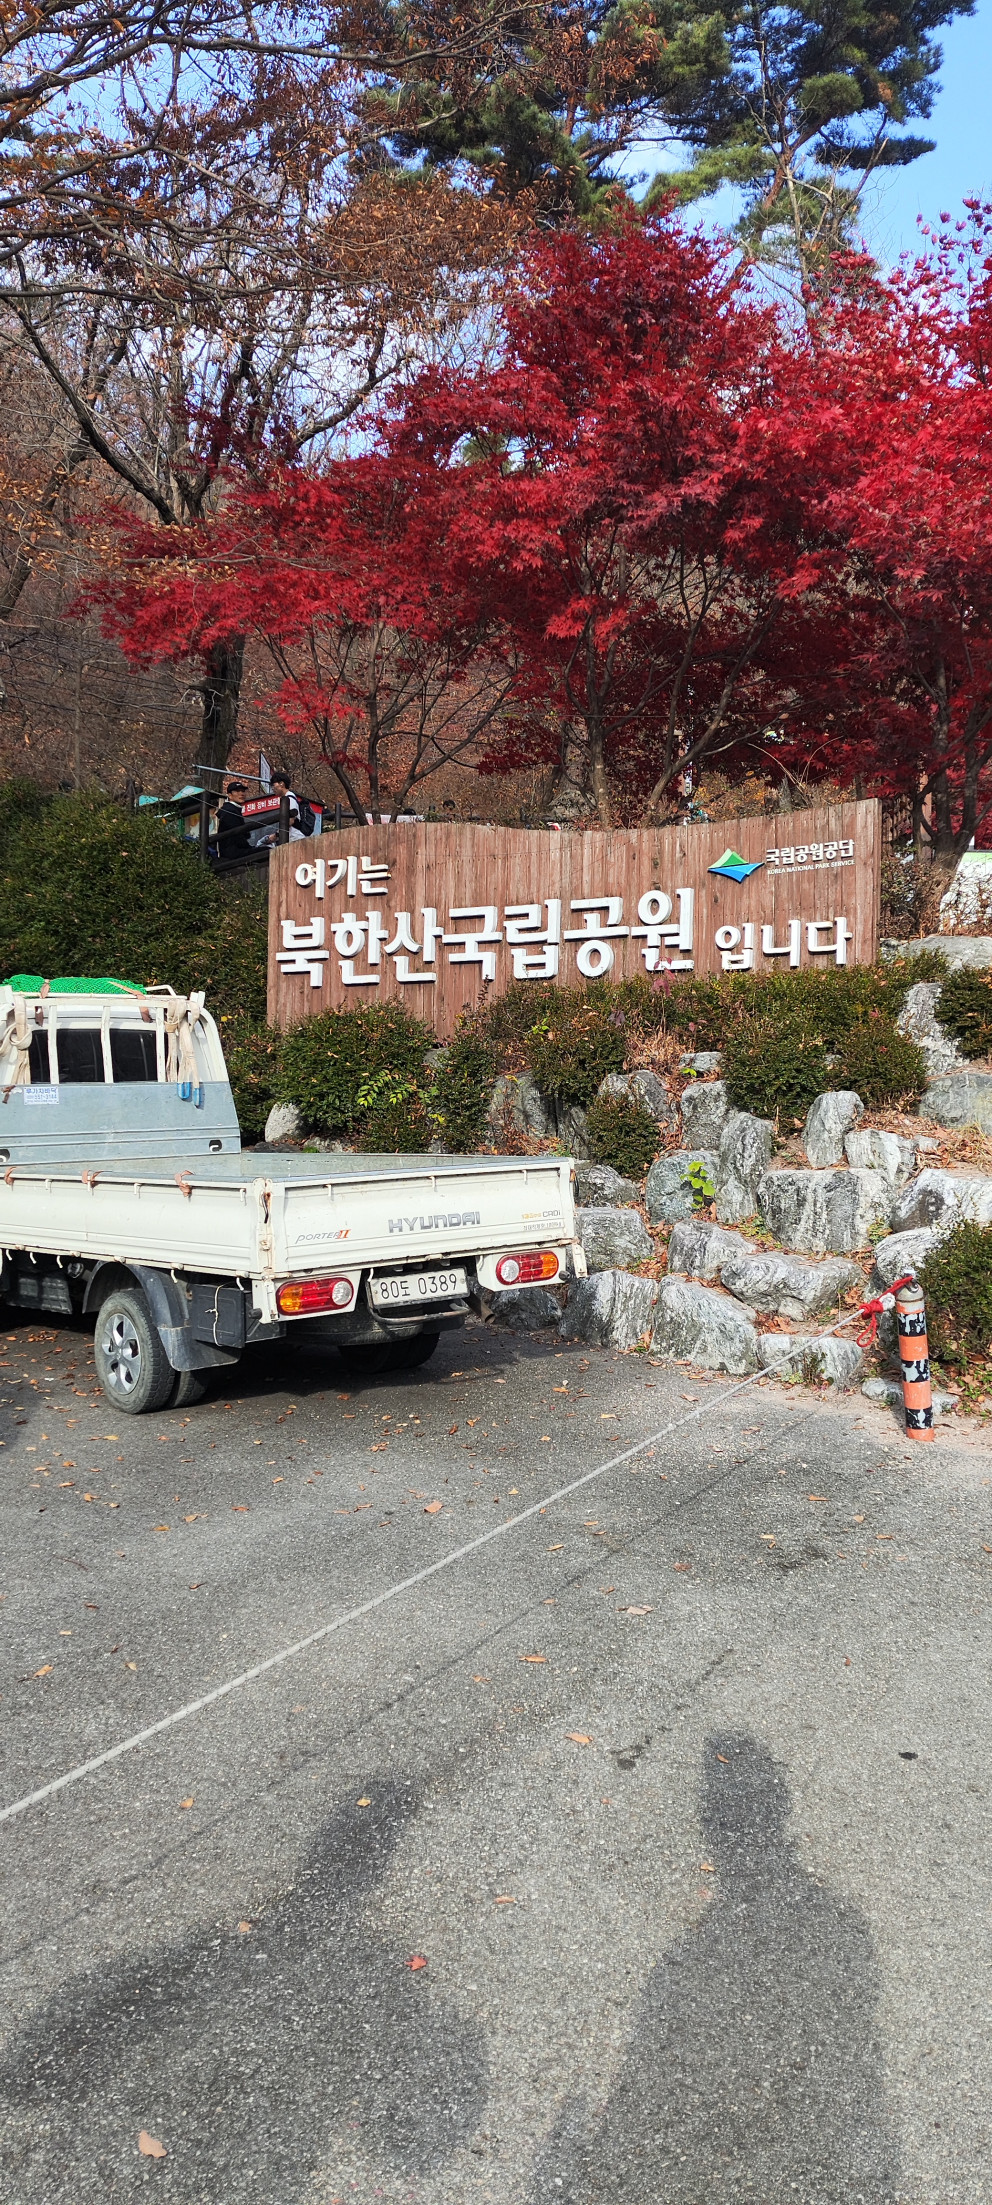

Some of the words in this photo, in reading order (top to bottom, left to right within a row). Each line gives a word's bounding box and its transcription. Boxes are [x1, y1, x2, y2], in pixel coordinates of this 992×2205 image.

[766, 839, 855, 865] 국립공원공단
[815, 862, 830, 870] PARK
[831, 859, 855, 867] SERVICE
[295, 855, 391, 898] 여기는
[275, 887, 696, 988] 북한산국립공원
[714, 917, 854, 971] 입니다
[388, 1211, 481, 1234] HYUNDAI
[380, 1281, 411, 1299] 80도
[418, 1273, 457, 1295] 0389
